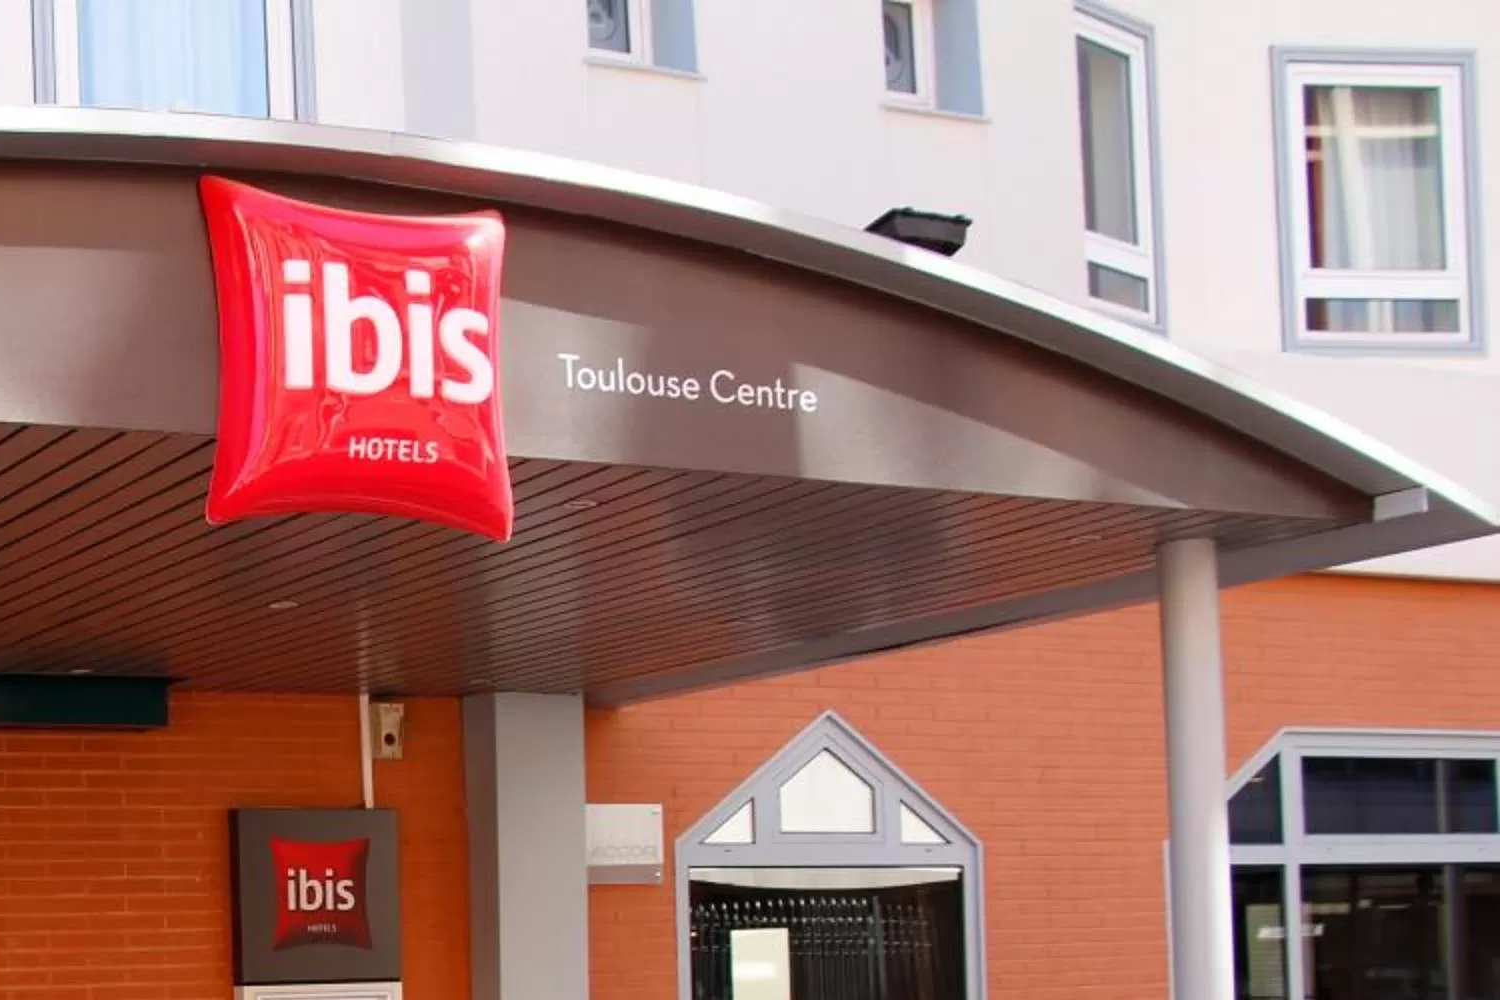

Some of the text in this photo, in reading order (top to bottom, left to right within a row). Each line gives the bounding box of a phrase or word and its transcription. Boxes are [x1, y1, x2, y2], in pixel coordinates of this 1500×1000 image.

[283, 259, 494, 405] ibis
[557, 353, 818, 412] Toulouse Centre
[348, 437, 438, 463] HOTELS
[287, 868, 355, 911] ibis
